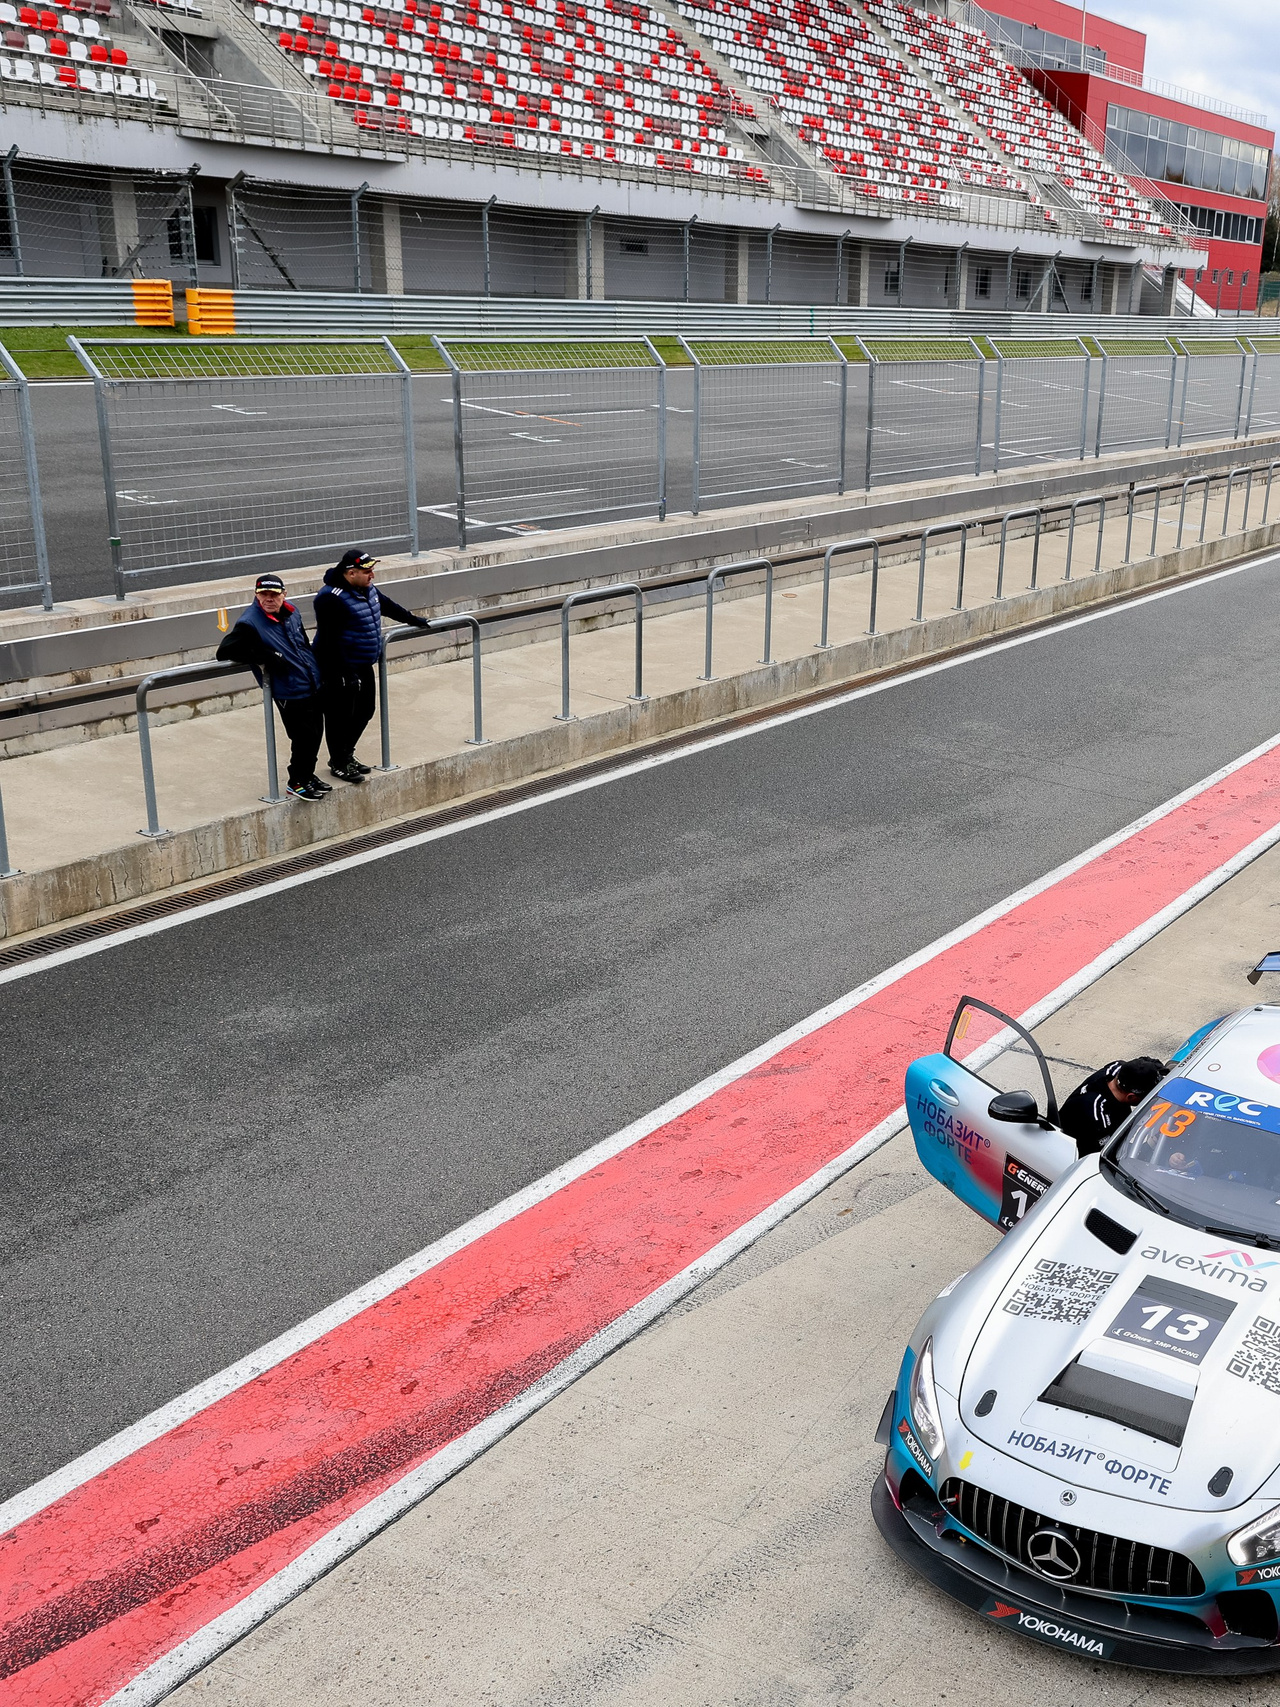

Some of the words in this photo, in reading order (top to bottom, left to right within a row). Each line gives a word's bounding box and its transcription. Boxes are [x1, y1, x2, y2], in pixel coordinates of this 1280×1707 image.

[1144, 1101, 1197, 1138] 13
[923, 1120, 972, 1165] ФОРТЕ
[1140, 1245, 1268, 1293] avexima
[1069, 1291, 1103, 1300] ФОРТЕ
[1141, 1304, 1210, 1342] 13
[1154, 1340, 1172, 1349] SMP
[1171, 1344, 1199, 1359] RACING
[905, 1431, 932, 1477] YOKOHAMA
[1104, 1459, 1172, 1495] ФОРТЕ
[1018, 1612, 1105, 1656] YOKOHAMA
